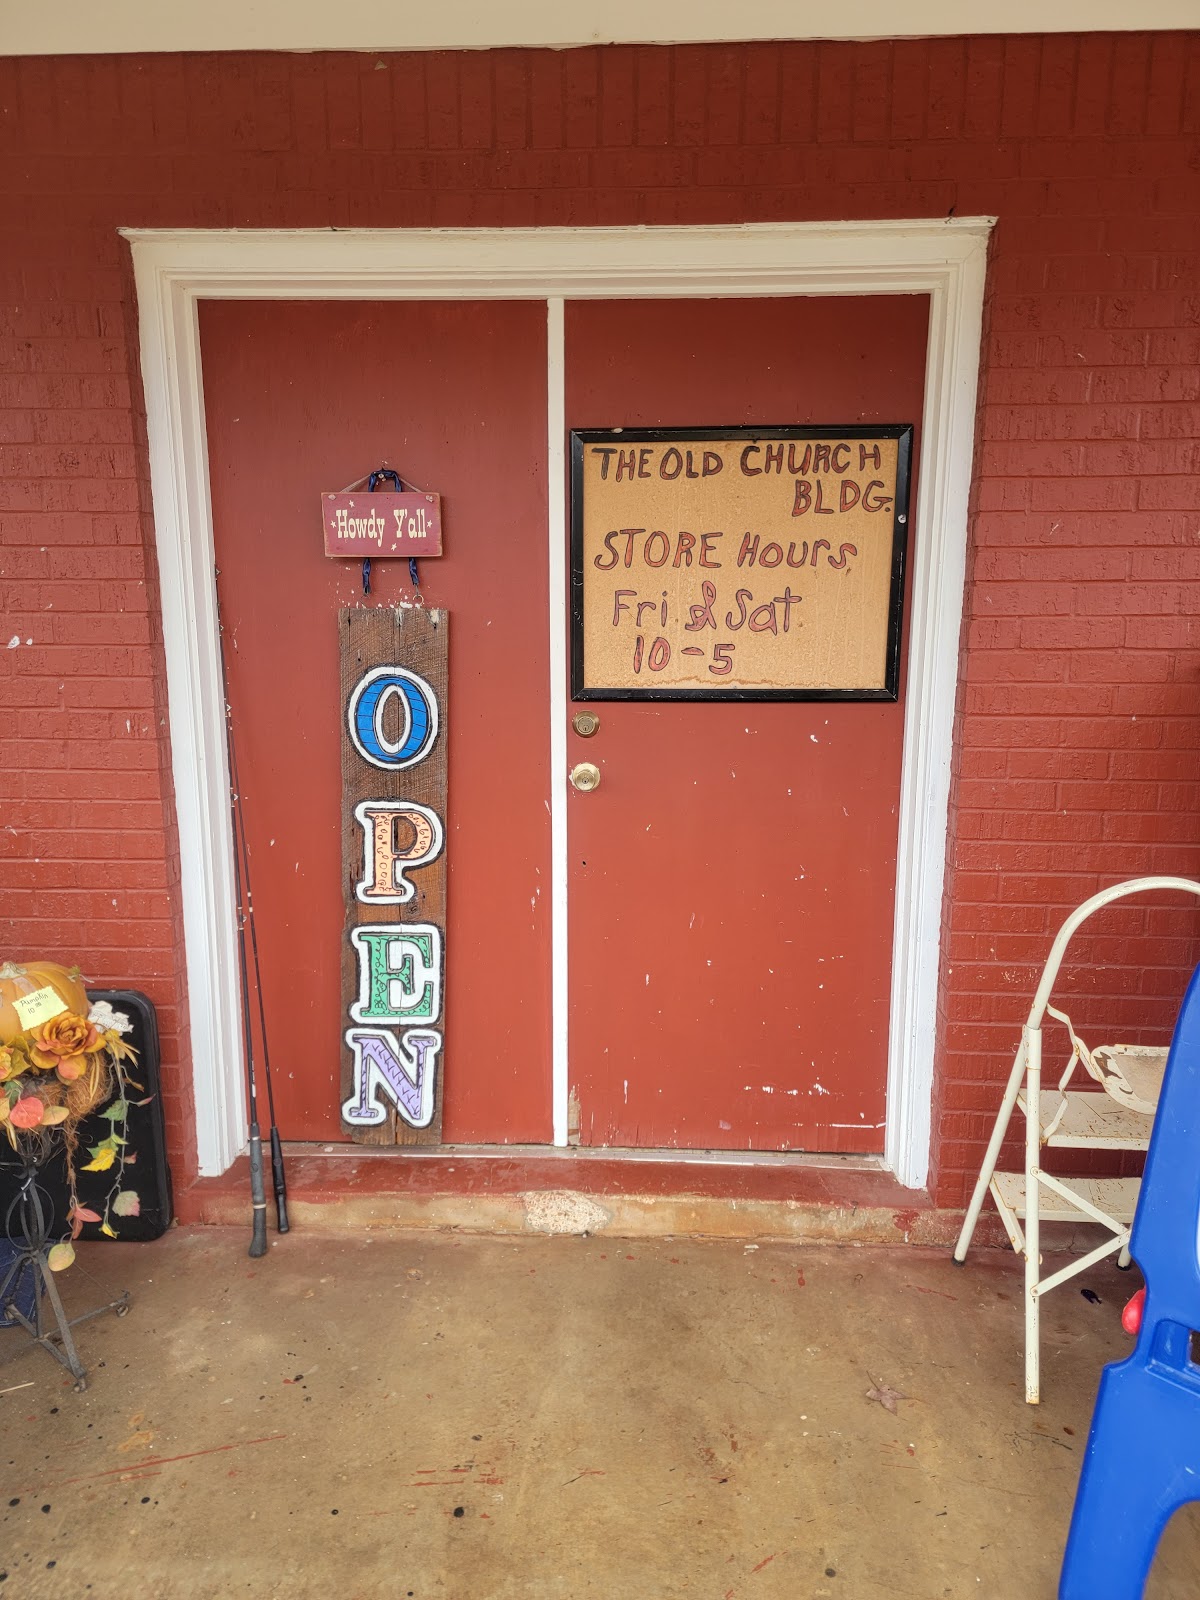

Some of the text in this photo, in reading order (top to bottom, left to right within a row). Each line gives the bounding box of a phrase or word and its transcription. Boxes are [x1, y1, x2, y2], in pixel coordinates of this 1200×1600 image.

[592, 444, 881, 482] THE OLD CHURCH
[792, 479, 893, 517] BLDG.
[335, 508, 427, 547] Howdy Y'all
[594, 529, 723, 570] STORE
[613, 589, 668, 627] Fri
[725, 587, 802, 635] Sat
[341, 665, 447, 1130] OPEN
